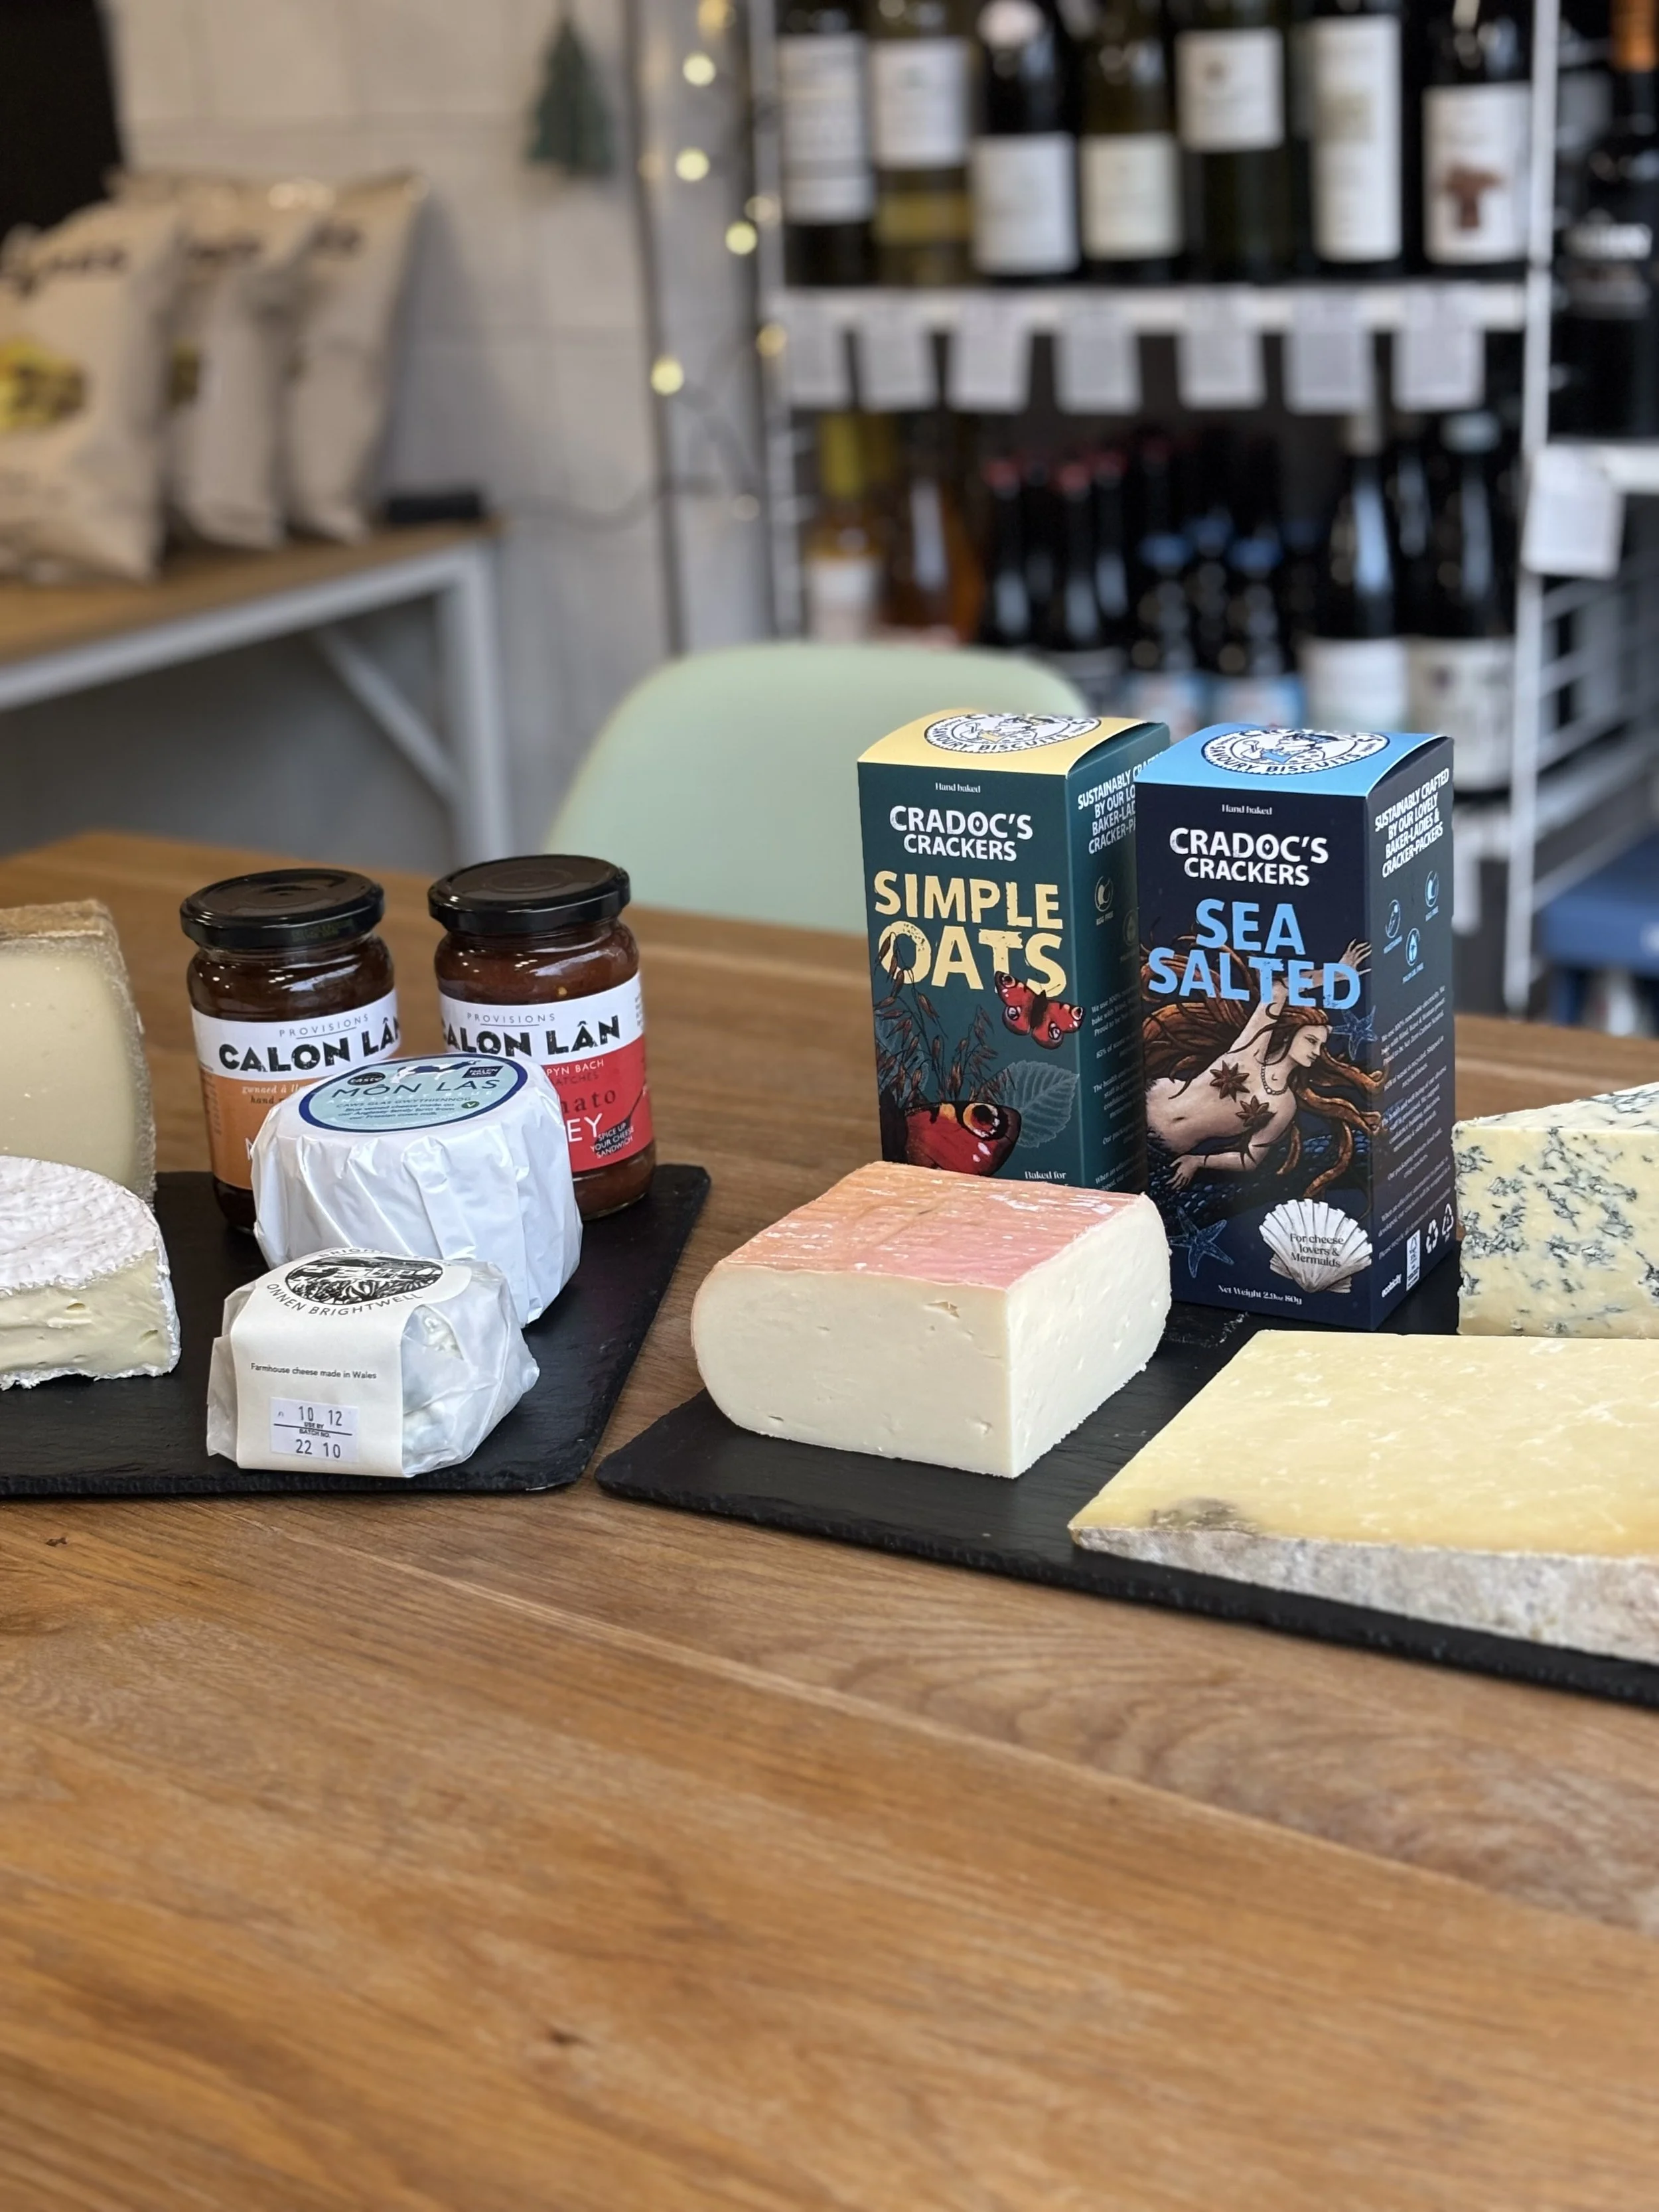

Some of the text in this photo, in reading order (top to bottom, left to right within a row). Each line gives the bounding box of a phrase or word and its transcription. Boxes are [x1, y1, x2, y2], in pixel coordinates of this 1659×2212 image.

[932, 727, 1070, 751] SAVOURY BISCUITS
[1209, 745, 1361, 773] SAVOURY BISCUITS
[934, 782, 981, 793] Hand baked
[1077, 769, 1131, 810] SUSTAINABLY
[1094, 800, 1106, 819] BY
[1107, 790, 1125, 811] OUR
[1222, 804, 1272, 816] Hand baked
[1375, 768, 1450, 832] SUSTAINABLY CRAFTED
[889, 805, 1033, 840] CRADOC'S
[1388, 792, 1439, 840] BY OUR LOVELY
[1385, 807, 1440, 859] BAKER-LADIES &
[903, 834, 1017, 861] CRACKERS
[1169, 828, 1329, 864] CRADOC'S
[1382, 821, 1443, 879] CRACKER-PACKERS
[1184, 857, 1310, 887] CRACKERS
[873, 871, 1063, 929] SIMPLE
[1195, 898, 1306, 956] SEA
[878, 921, 1067, 997] OATS
[1148, 947, 1361, 1010] SALTED
[279, 1013, 369, 1037] PROVISIONS
[467, 1012, 555, 1023] PROVISIONS
[441, 1015, 620, 1057] ALON LÂN
[218, 1037, 351, 1072] CALON
[546, 1059, 605, 1076] PYN BACH
[555, 1071, 599, 1086] ATCHES
[250, 1095, 274, 1104] hand
[331, 1079, 500, 1099] MÔN LAS
[590, 1139, 612, 1153] YOUR
[612, 1125, 634, 1143] CHEESE
[597, 1127, 617, 1142] SPICE
[617, 1122, 626, 1132] UP
[595, 1136, 633, 1159] SANDWICH
[1024, 1171, 1067, 1179] Baked for
[1290, 1233, 1344, 1245] For cheese
[1299, 1244, 1331, 1256] lovers
[1291, 1252, 1341, 1268] Mermaids
[267, 1284, 423, 1316] ONNEN BRIGHTWELL
[1218, 1284, 1232, 1293] Net
[1233, 1287, 1261, 1298] Weight
[251, 1363, 290, 1374] Farmhouse
[292, 1366, 319, 1376] cheese
[320, 1369, 341, 1378] made
[352, 1370, 377, 1379] Wales
[298, 1406, 343, 1427] 10 12
[299, 1428, 319, 1437] BATCH
[295, 1438, 341, 1459] 22 10
